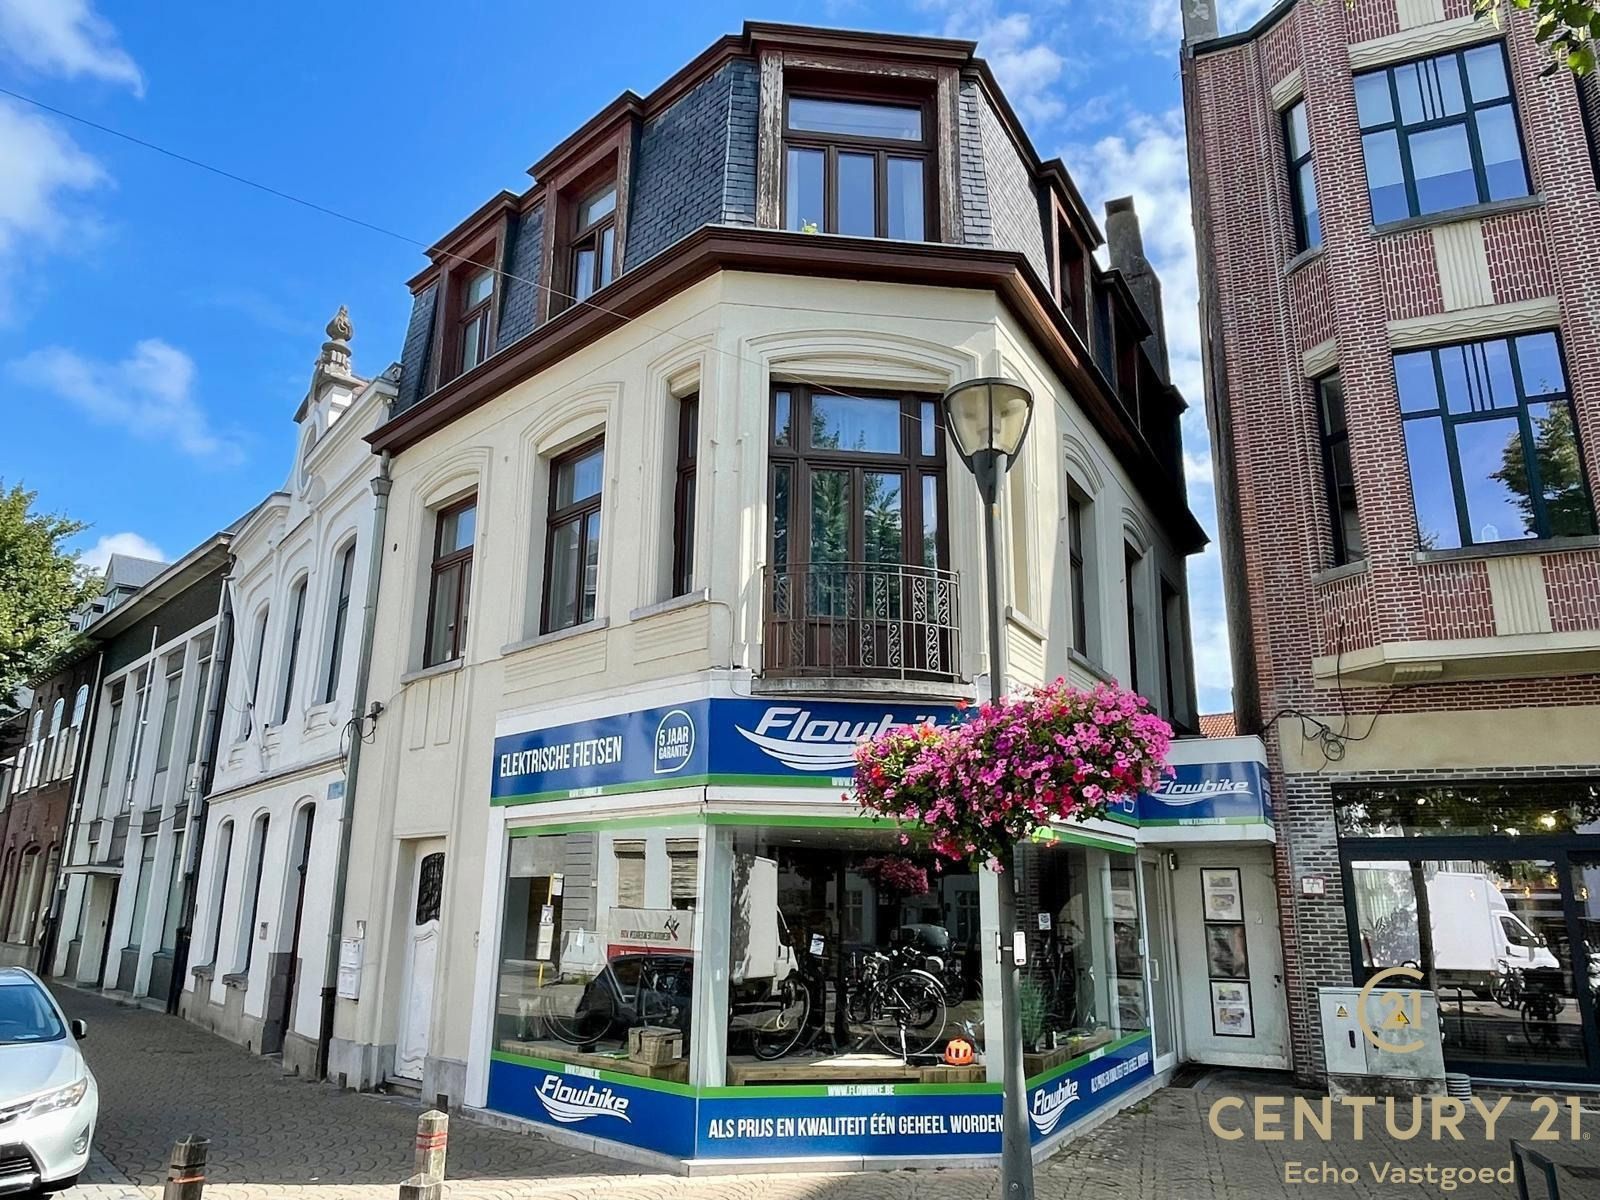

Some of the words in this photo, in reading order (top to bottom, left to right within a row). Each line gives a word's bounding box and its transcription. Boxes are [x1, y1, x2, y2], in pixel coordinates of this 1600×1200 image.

[658, 729, 666, 747] 5
[666, 726, 689, 745] JAAR
[500, 743, 571, 777] ELEKTRISCHE
[572, 736, 623, 768] FIETSEN
[658, 744, 689, 760] GARANTIE
[1152, 778, 1249, 794] Flowbike
[541, 1074, 629, 1114] Flowbike
[827, 1085, 895, 1097] WWW.FLOWBIKE.BE
[1033, 1078, 1079, 1115] Flowbike
[708, 1119, 734, 1139] ALS
[737, 1118, 773, 1139] PRIJS
[777, 1118, 795, 1138] EN
[797, 1117, 867, 1137] KWALITEIT
[870, 1112, 895, 1136] ÉÉN
[899, 1115, 948, 1135] GEHEEL
[950, 1114, 1004, 1134] WORDEN
